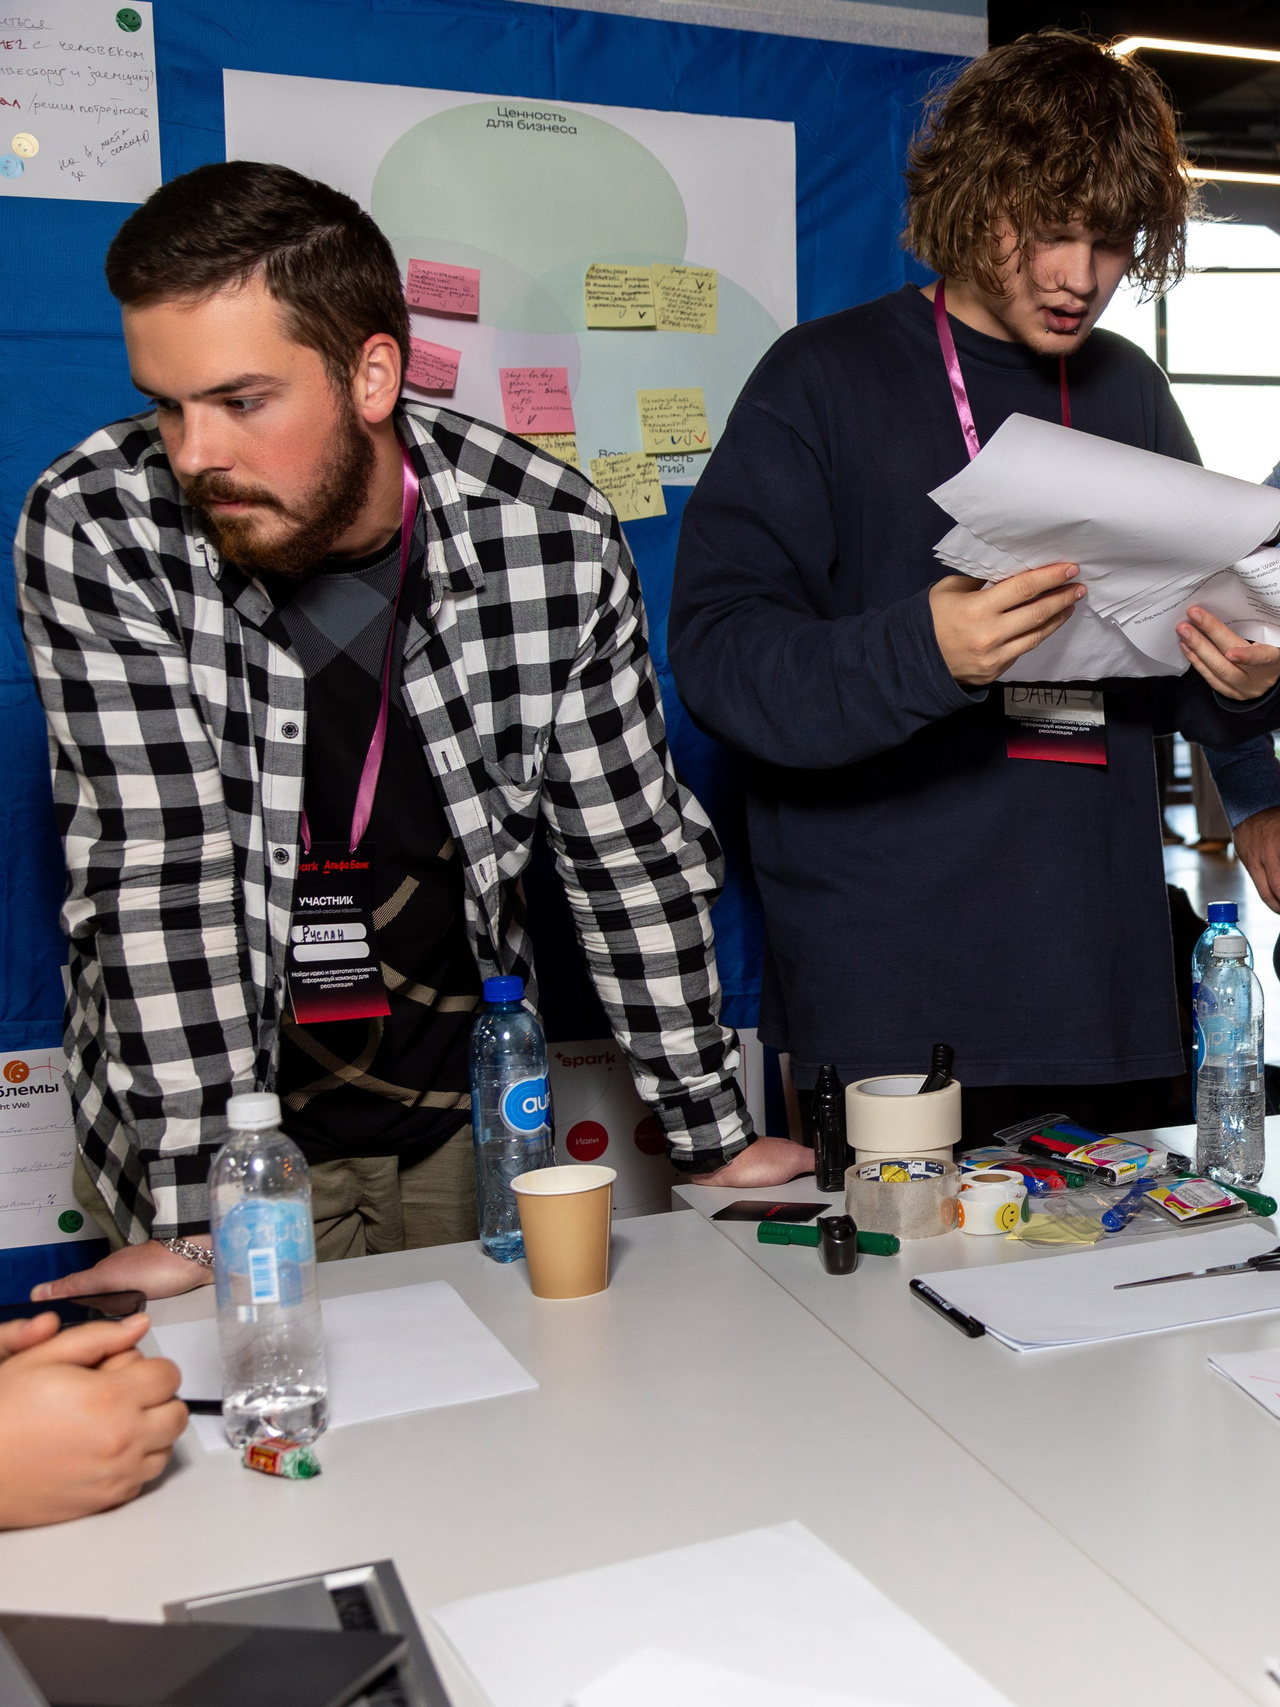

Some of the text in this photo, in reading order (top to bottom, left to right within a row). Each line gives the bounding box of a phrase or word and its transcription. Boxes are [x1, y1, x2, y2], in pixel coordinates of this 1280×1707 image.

[497, 106, 567, 122] Ценность
[486, 118, 578, 135] для бизнеса
[323, 859, 350, 873] Альфа
[350, 859, 370, 870] Банк
[298, 895, 354, 907] УЧАСТНИК
[291, 970, 309, 978] Найди
[329, 968, 354, 976] прототип
[302, 973, 370, 985] сформируй команду для
[320, 981, 354, 990] реализации
[562, 1051, 616, 1069] spark
[12, 1100, 31, 1110] We)
[575, 1137, 600, 1146] Идеи
